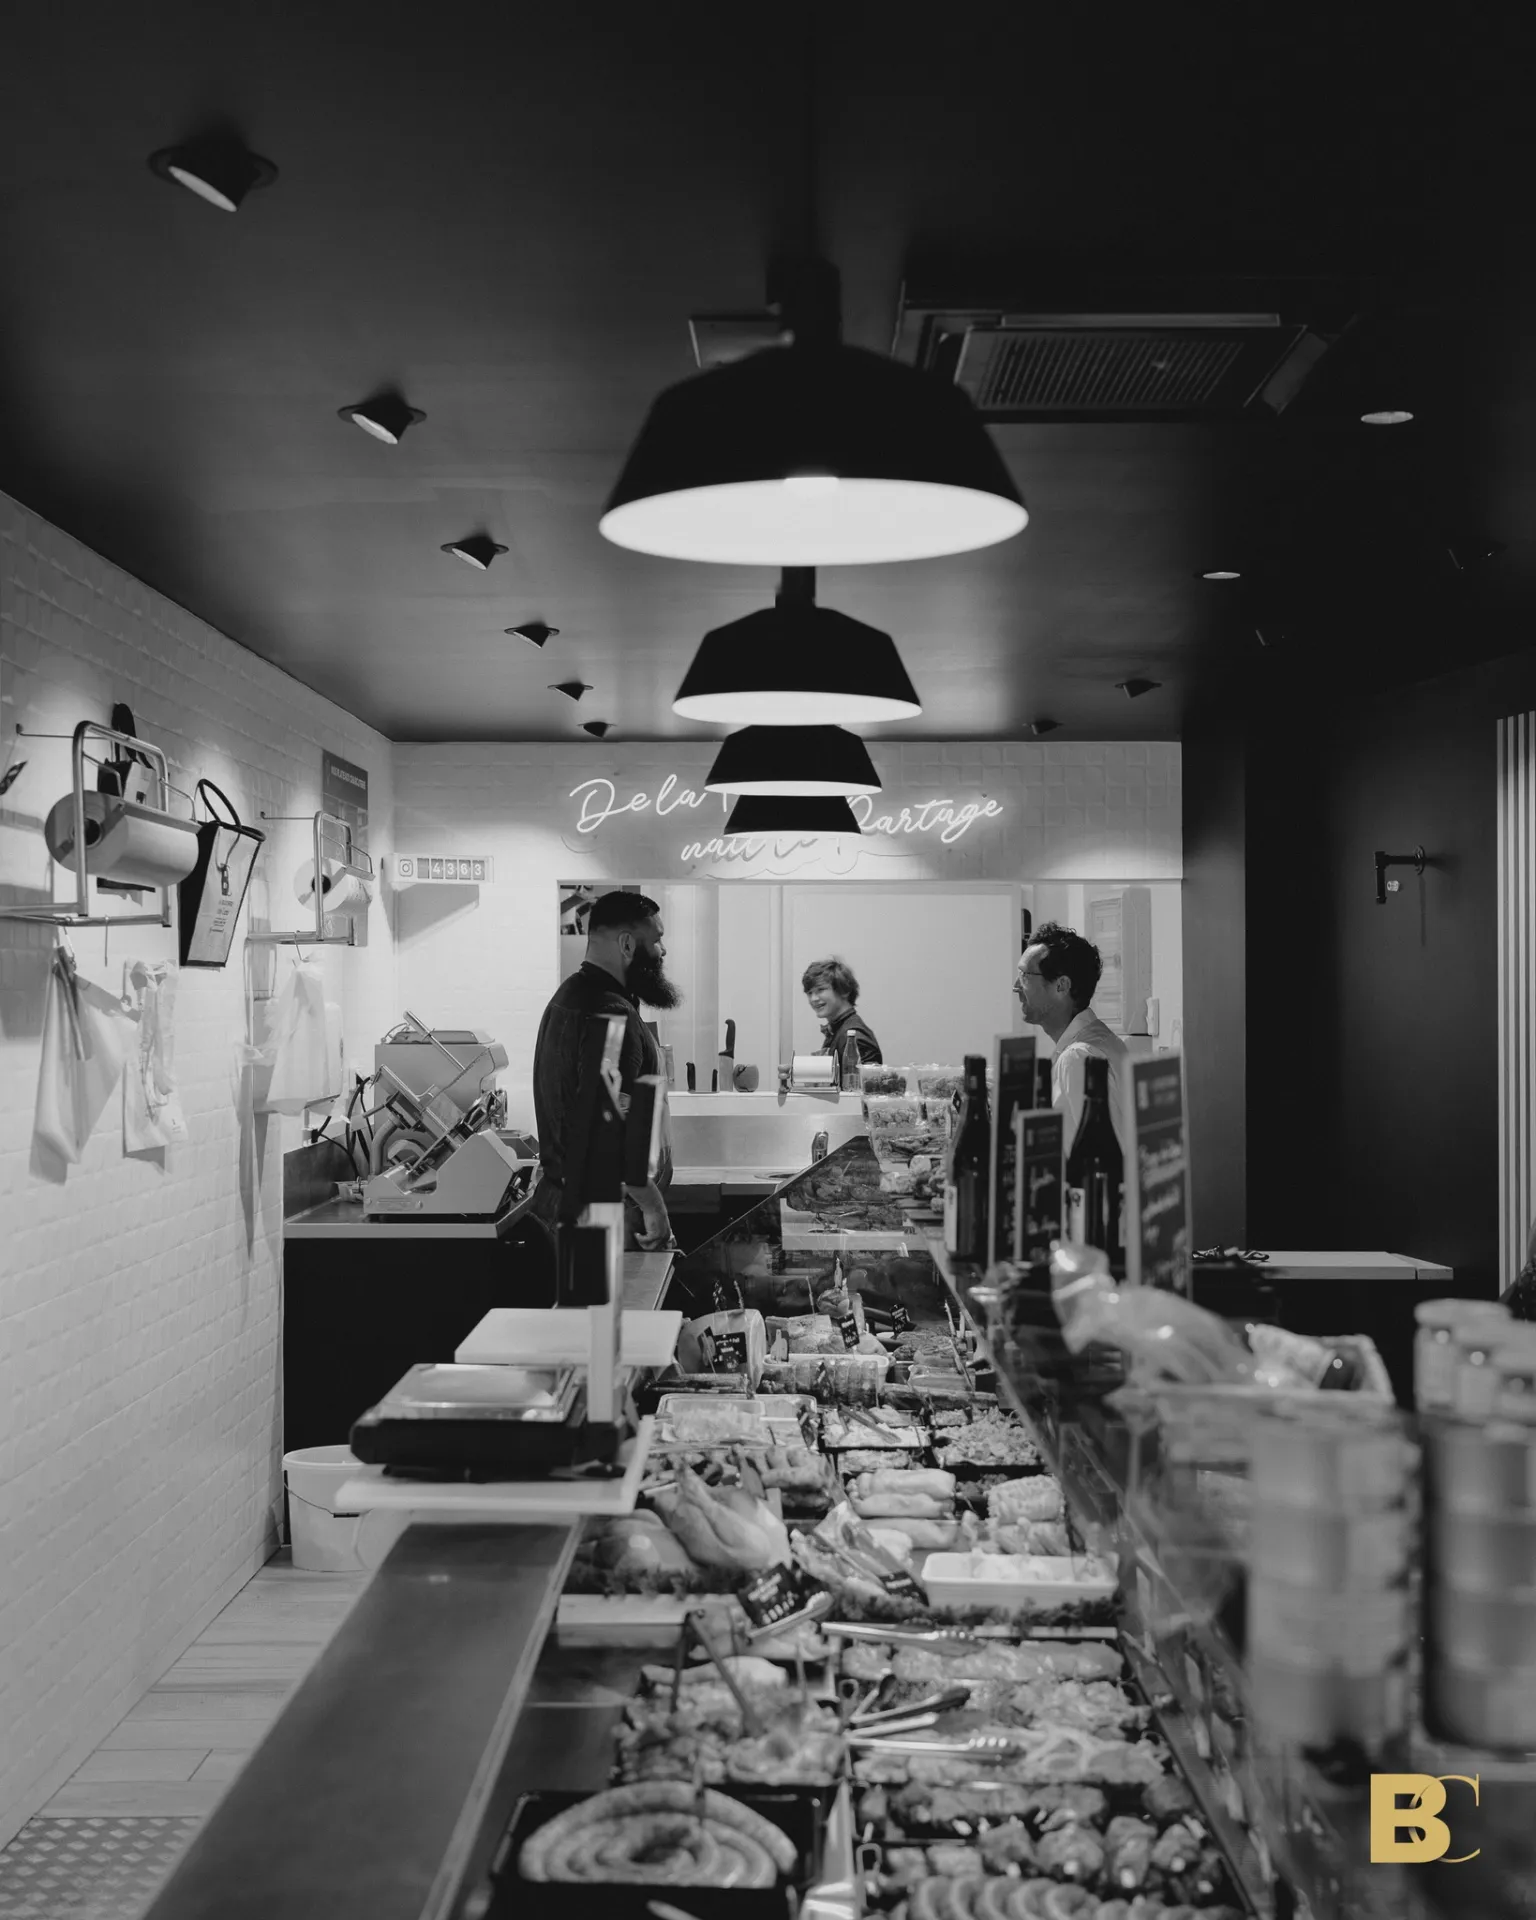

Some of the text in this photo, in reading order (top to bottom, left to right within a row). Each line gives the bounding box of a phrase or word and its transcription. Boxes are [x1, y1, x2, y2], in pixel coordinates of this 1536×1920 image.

[569, 778, 652, 833] De
[656, 774, 707, 815] la
[432, 862, 482, 876] 4363
